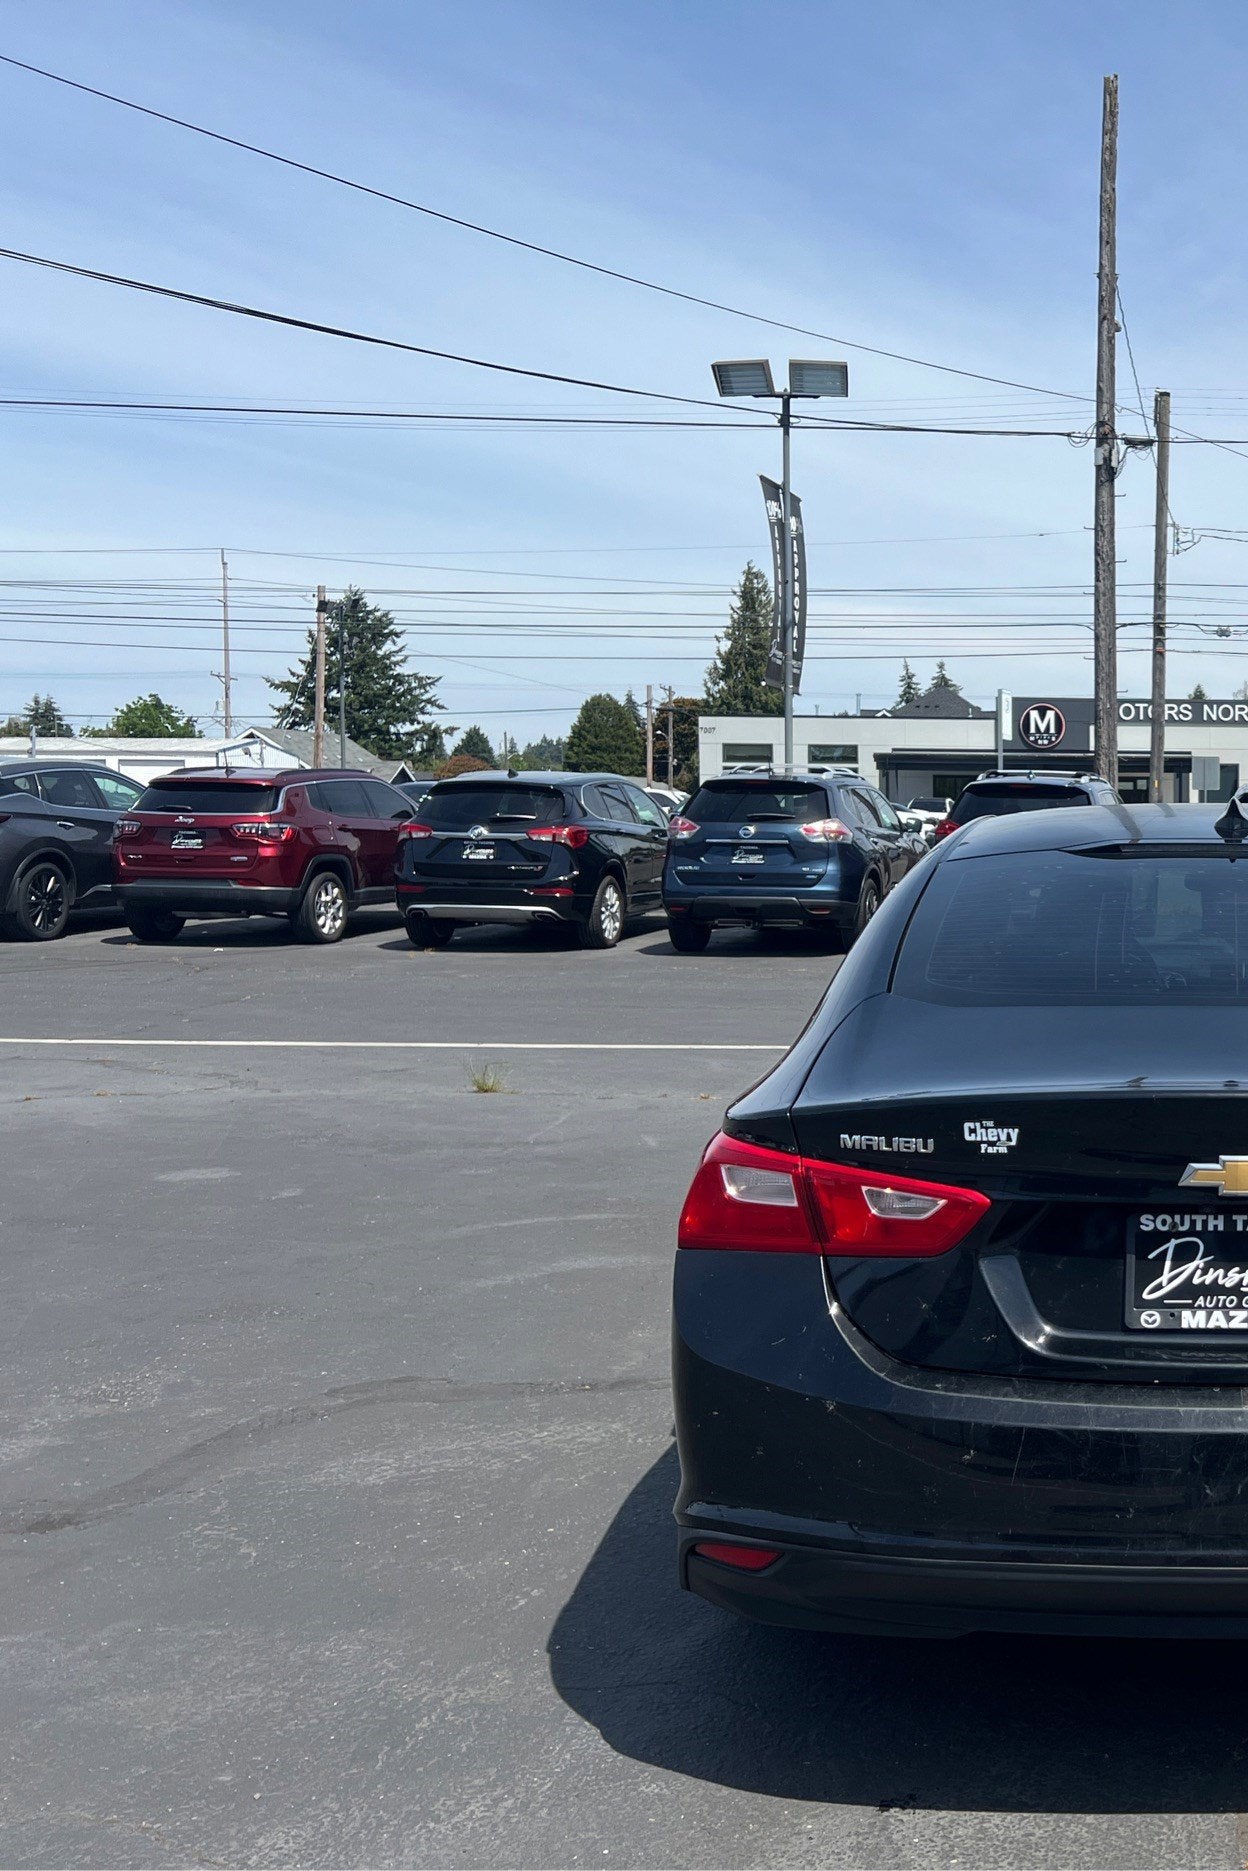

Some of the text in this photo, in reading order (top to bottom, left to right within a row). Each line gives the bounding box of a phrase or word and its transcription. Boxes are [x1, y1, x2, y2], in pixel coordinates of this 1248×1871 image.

[1118, 703, 1193, 721] OTRS
[1029, 709, 1055, 734] M
[963, 1122, 1019, 1146] Chevy
[839, 1133, 935, 1154] MALIBU
[980, 1143, 1008, 1154] Farm
[1139, 1214, 1225, 1232] SOUTH
[1194, 1296, 1237, 1308] AUTO
